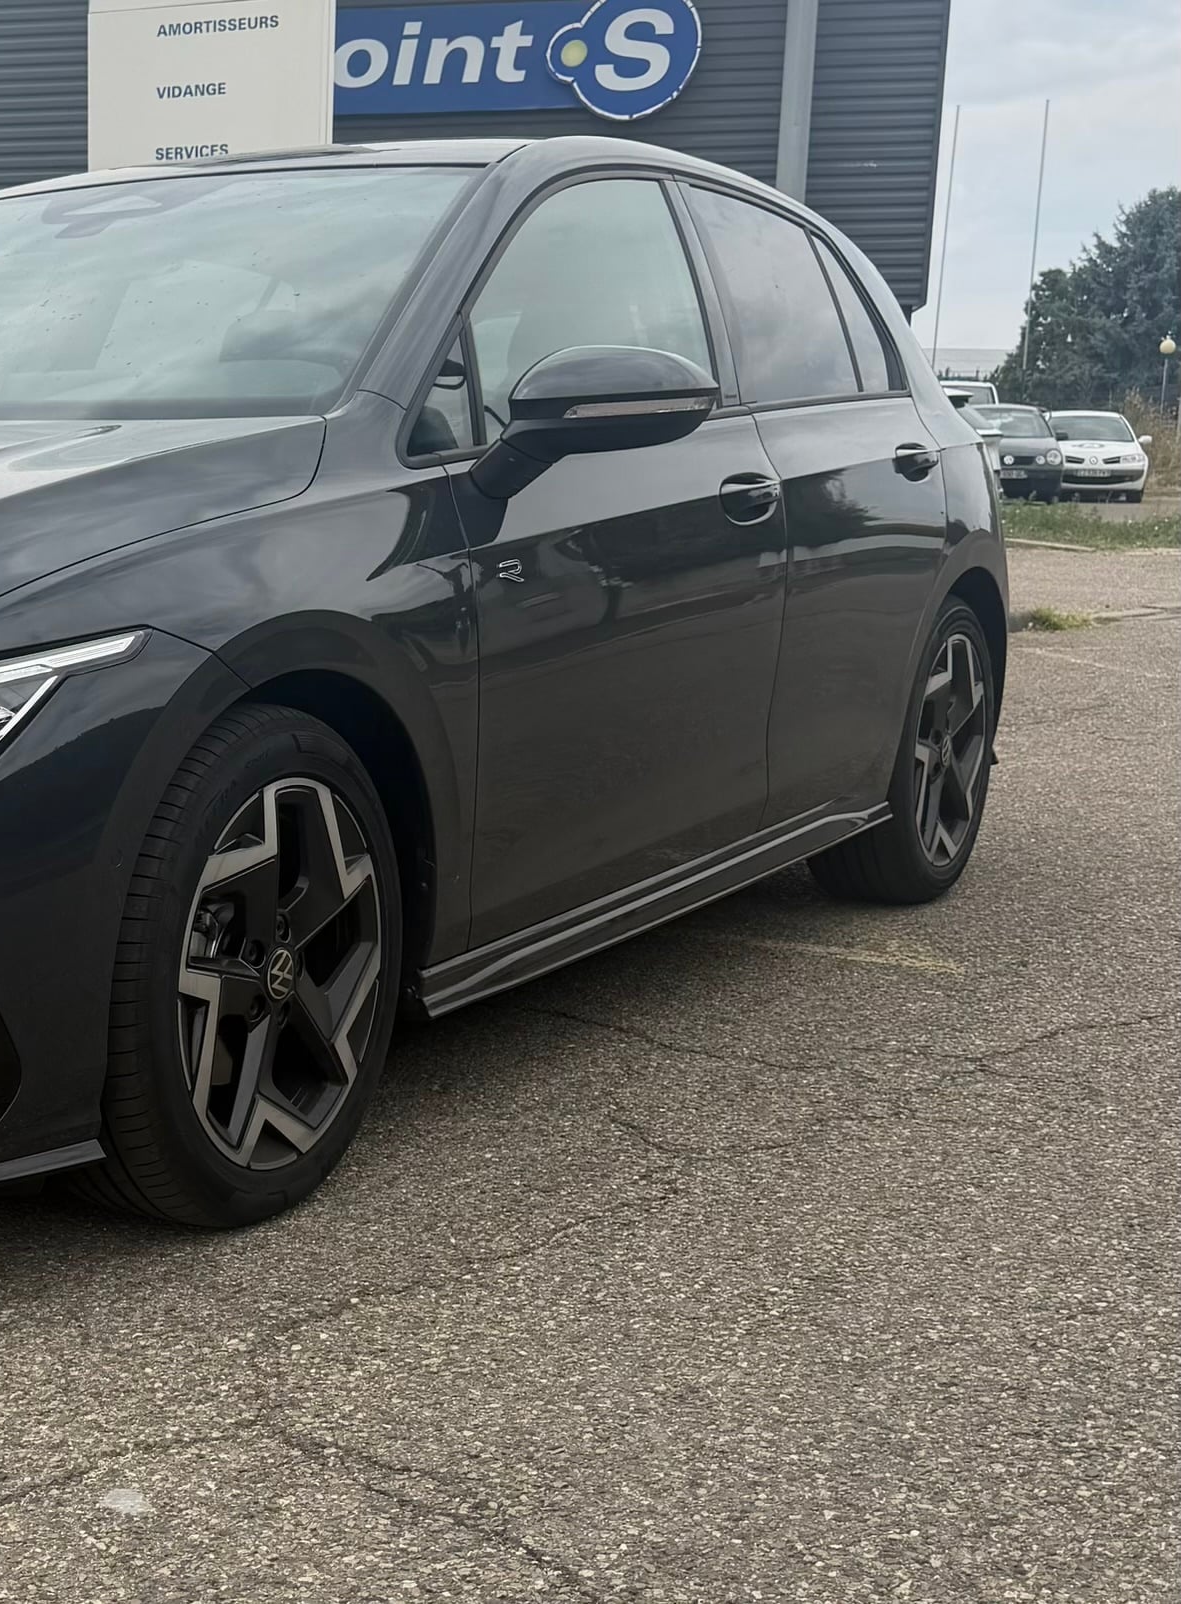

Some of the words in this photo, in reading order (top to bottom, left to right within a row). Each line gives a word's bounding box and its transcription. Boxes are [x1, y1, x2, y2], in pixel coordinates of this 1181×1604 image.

[156, 14, 280, 38] AMORTISSEURS
[334, 20, 533, 88] oint
[595, 8, 675, 91] S
[156, 82, 227, 99] VIDANGE
[155, 143, 229, 160] SERVICES
